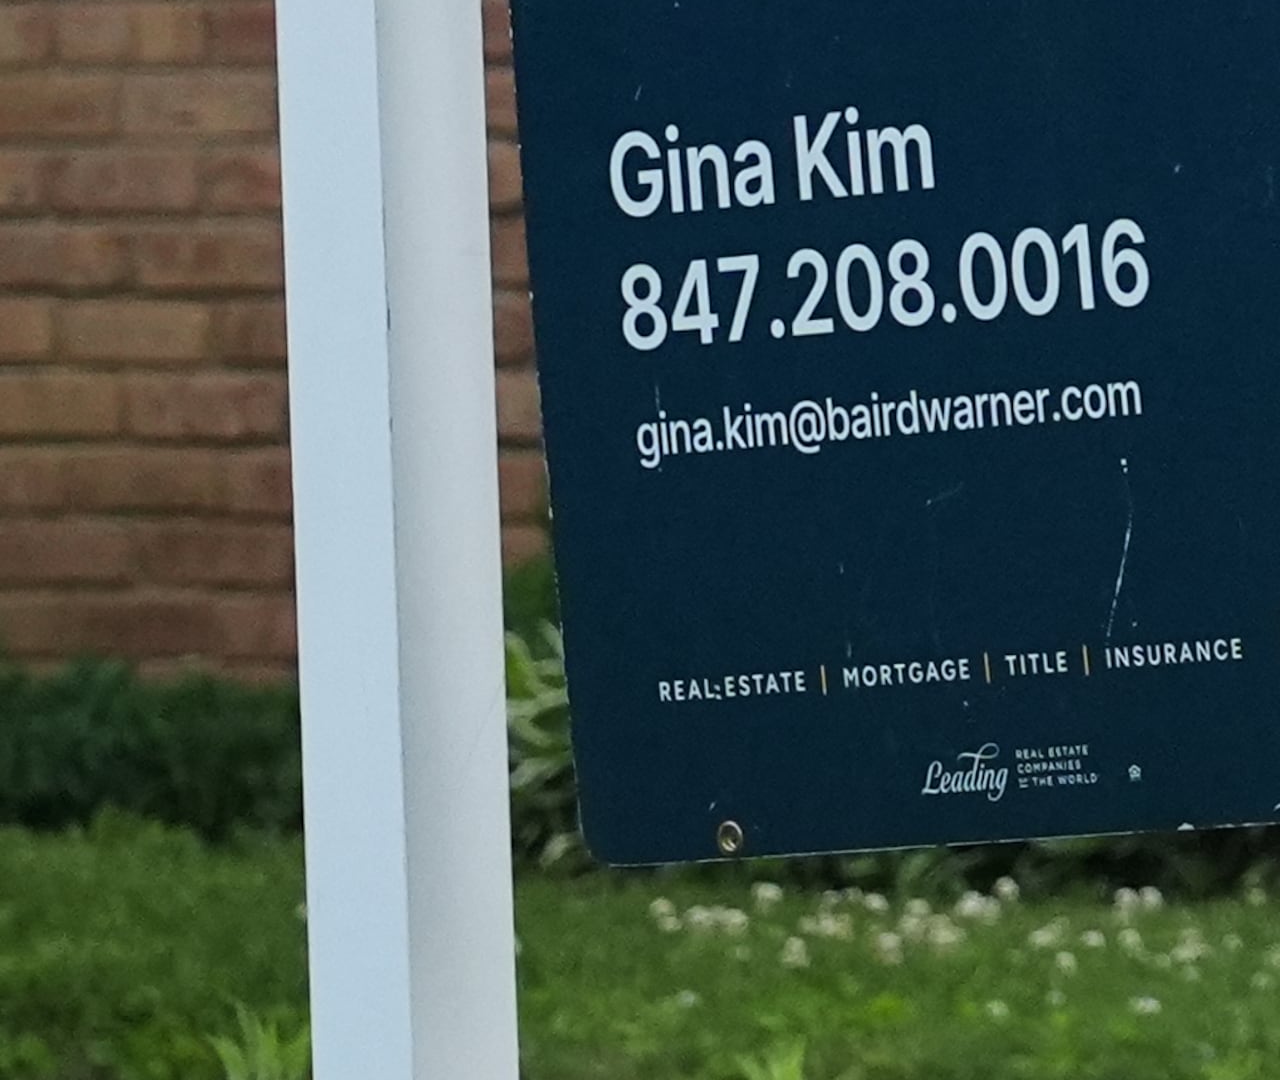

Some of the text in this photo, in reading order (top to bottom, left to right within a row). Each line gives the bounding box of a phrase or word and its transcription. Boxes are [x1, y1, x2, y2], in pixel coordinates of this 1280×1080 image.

[609, 106, 935, 218] Gina Kim
[620, 218, 1150, 351] 847.208.0016
[636, 380, 1143, 469] gina.kim@bairdwarner.com
[1004, 651, 1069, 676] TITLE
[1105, 637, 1244, 669] INSURANCE
[658, 670, 806, 703] REAL ESTATE
[842, 658, 971, 688] MORTGAGE
[1015, 744, 1089, 760] REAL ESTATE
[1016, 759, 1082, 775] COMPANIES
[921, 742, 1009, 802] Leading
[1031, 775, 1054, 787] THE
[1057, 772, 1098, 786] WORLD
